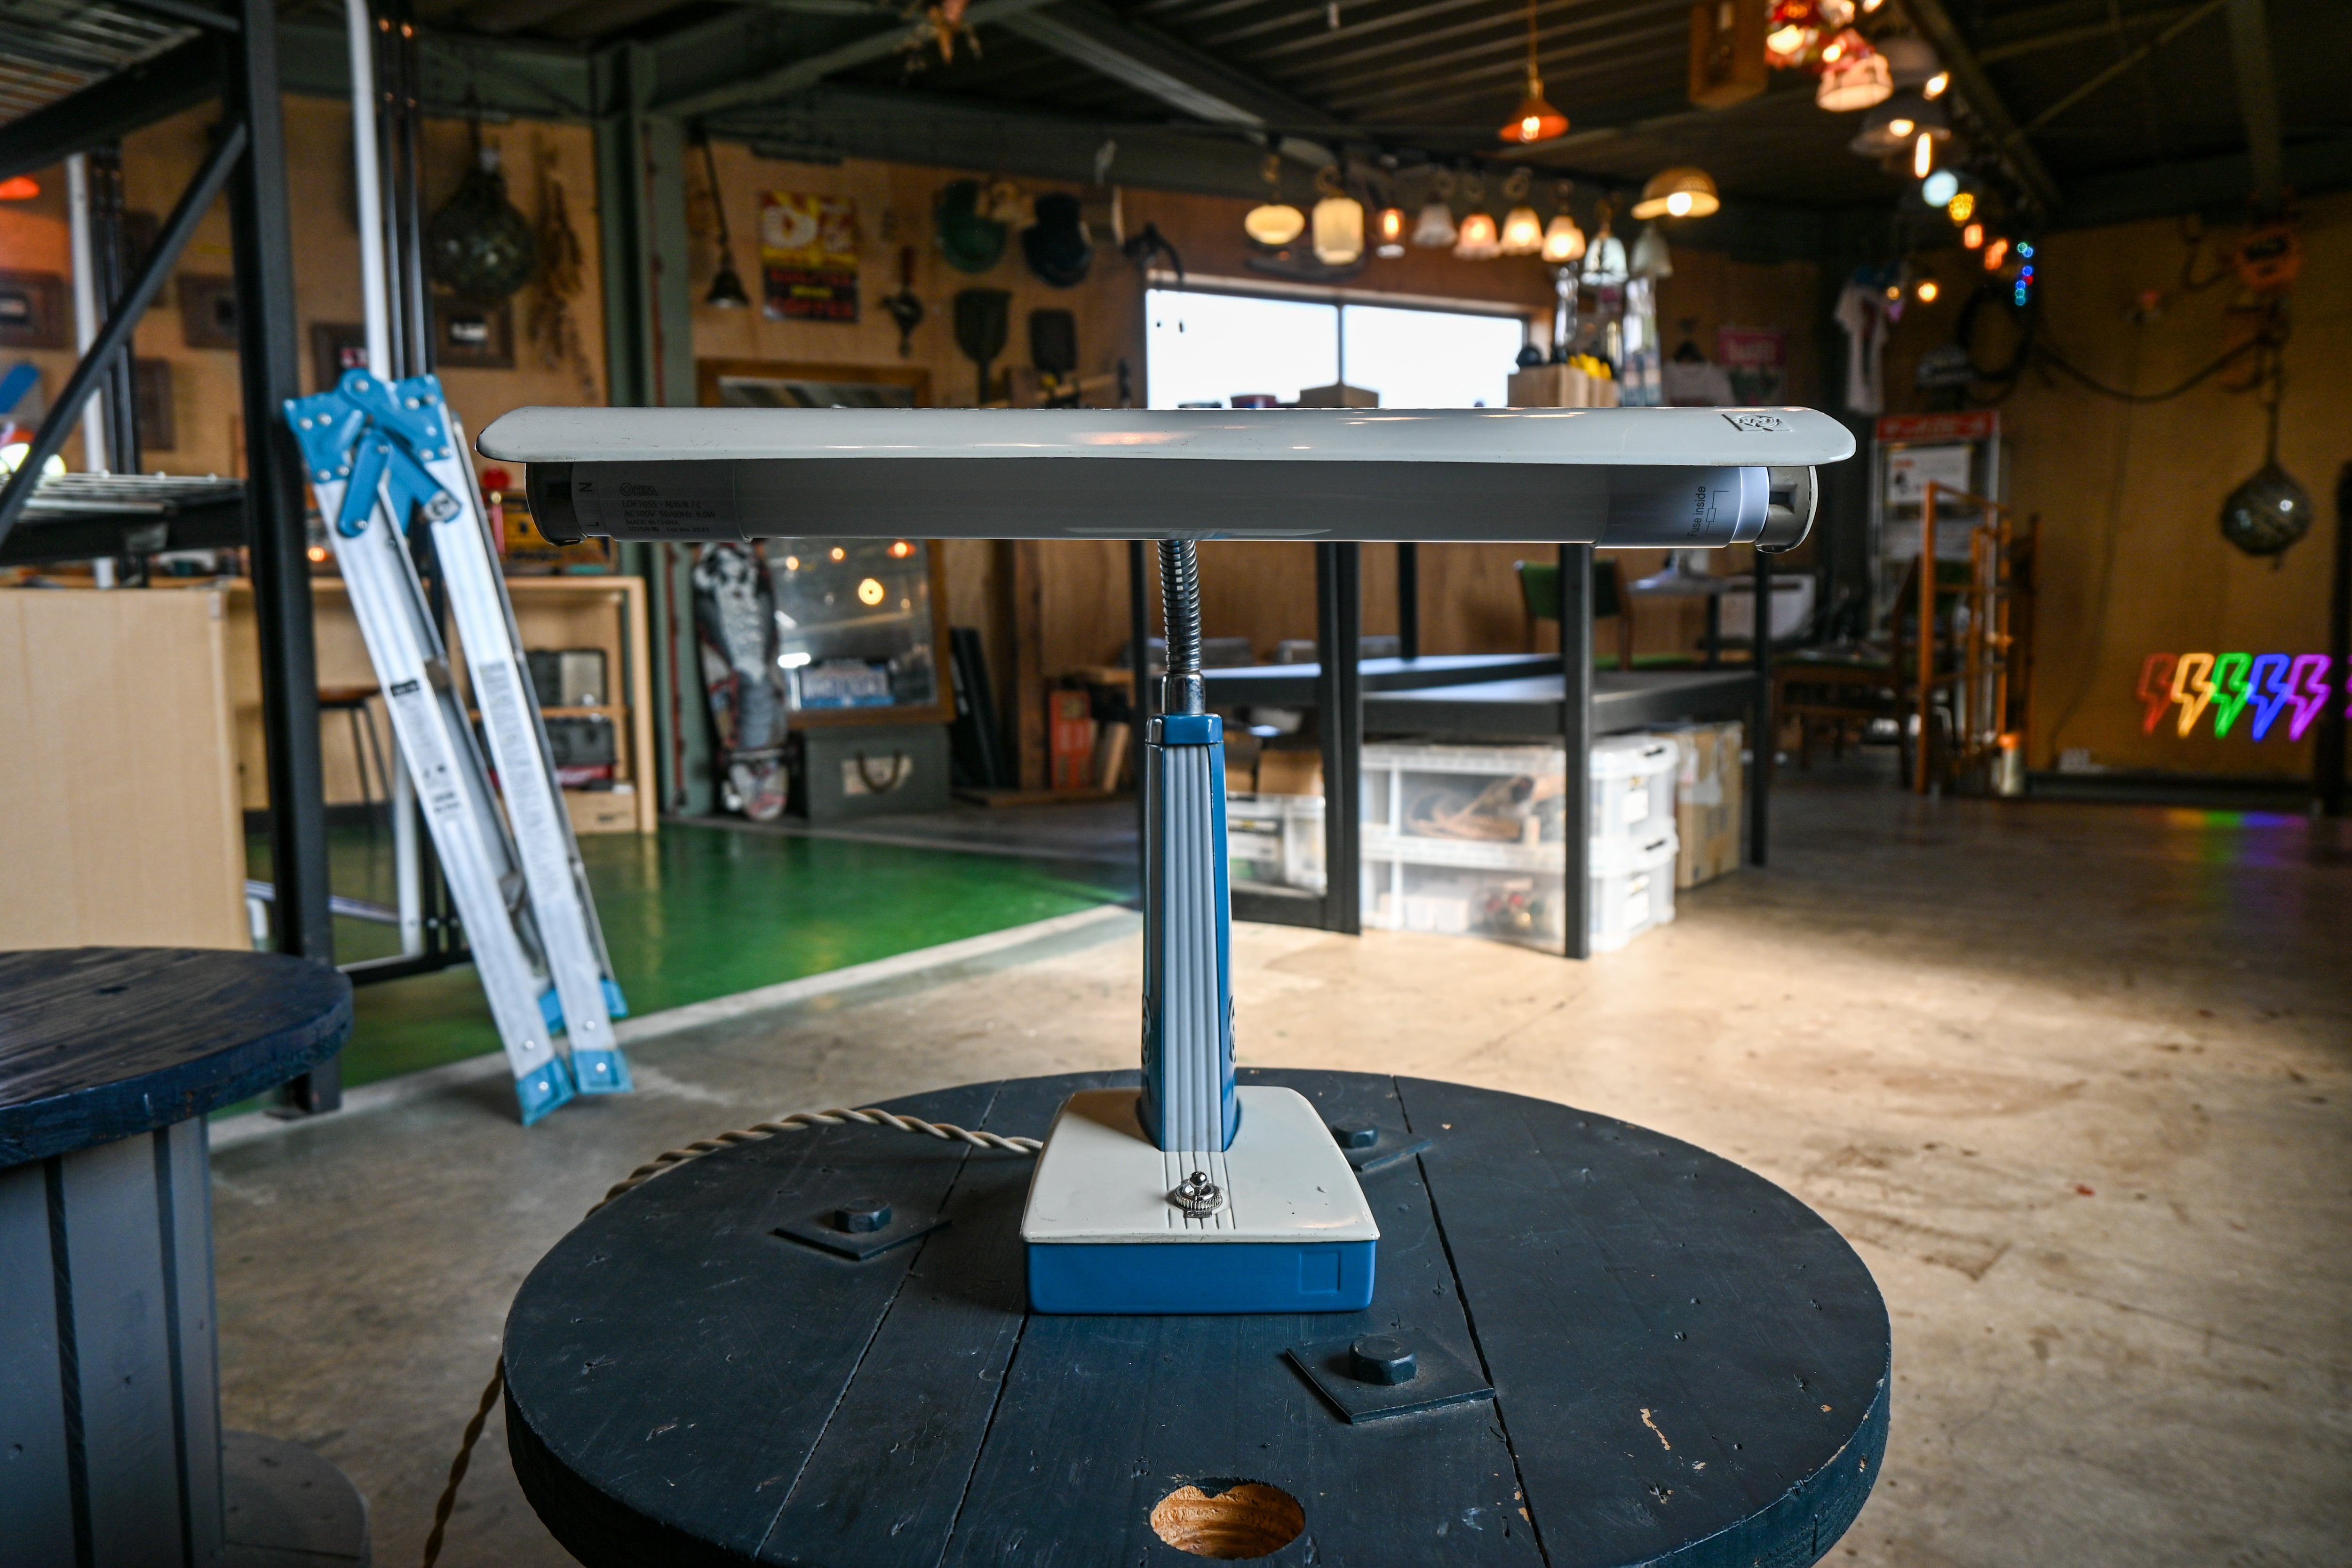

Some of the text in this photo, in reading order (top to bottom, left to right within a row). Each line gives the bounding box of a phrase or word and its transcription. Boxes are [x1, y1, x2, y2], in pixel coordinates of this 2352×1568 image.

[620, 482, 659, 496] OHM
[1687, 486, 1706, 537] Fuse inside
